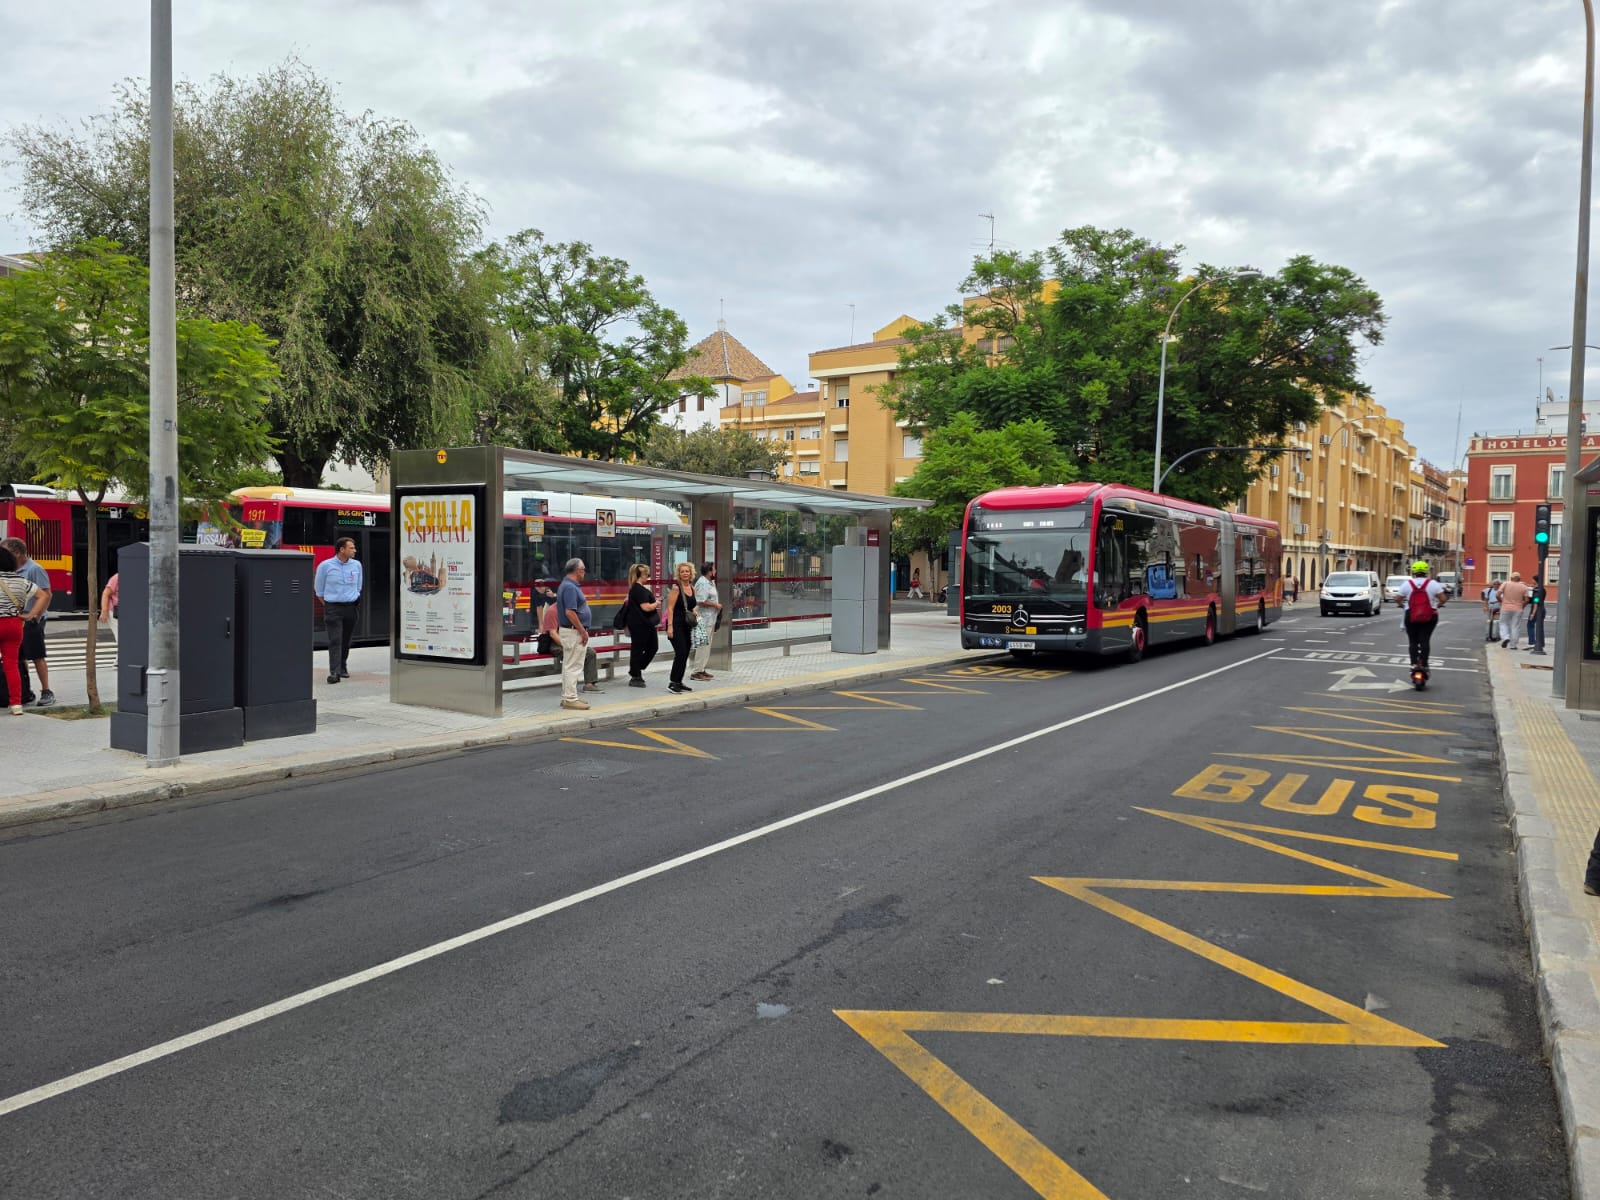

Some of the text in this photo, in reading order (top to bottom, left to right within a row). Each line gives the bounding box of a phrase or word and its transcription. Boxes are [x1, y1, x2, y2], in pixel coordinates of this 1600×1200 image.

[1488, 437, 1595, 449] HOTEL DOA
[248, 509, 266, 521] 1911
[403, 500, 472, 532] SEVILLA
[598, 511, 613, 527] 50
[408, 525, 469, 543] ESPECIAL
[991, 605, 1012, 613] 2003
[1171, 763, 1439, 829] BUS
